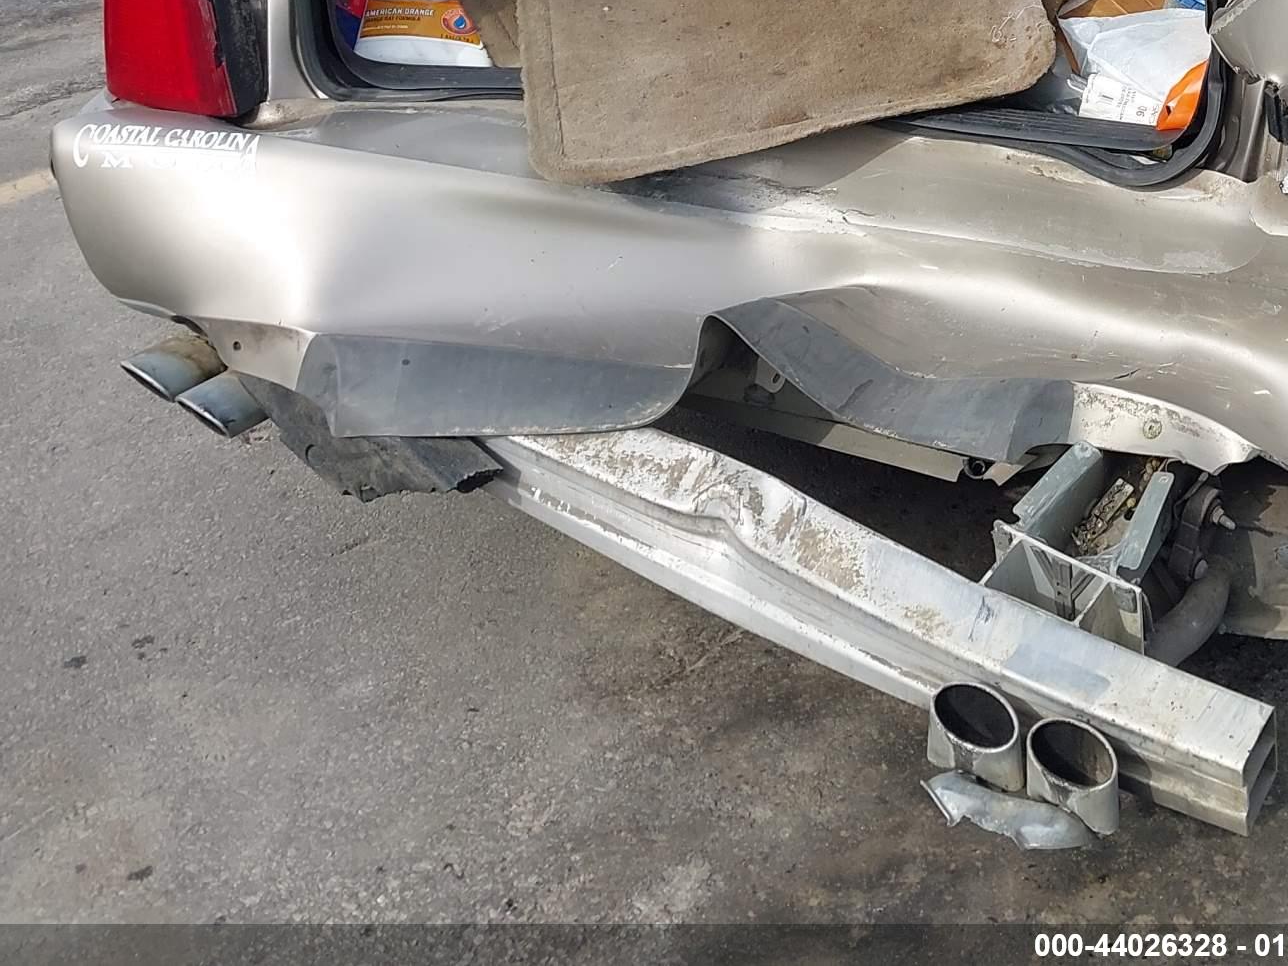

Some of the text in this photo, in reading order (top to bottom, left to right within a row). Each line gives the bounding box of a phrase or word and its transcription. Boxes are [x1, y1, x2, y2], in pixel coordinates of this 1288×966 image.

[404, 8, 434, 16] ORANGE
[73, 123, 162, 167] COASTAL
[164, 128, 261, 164] CAROLINA
